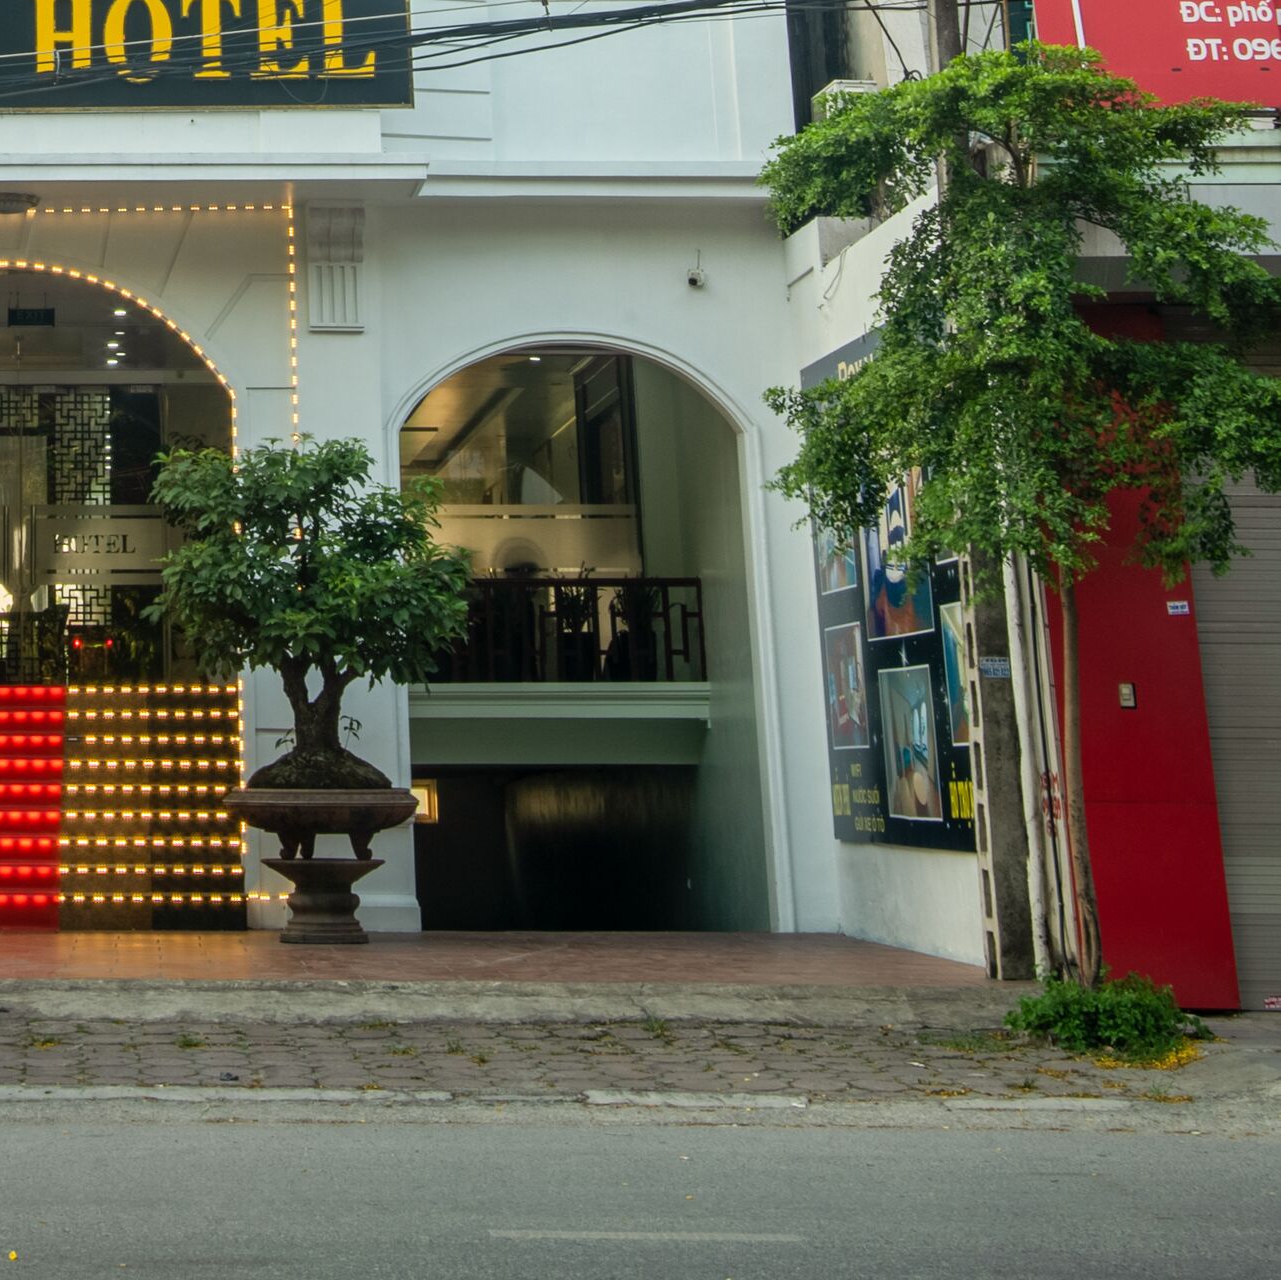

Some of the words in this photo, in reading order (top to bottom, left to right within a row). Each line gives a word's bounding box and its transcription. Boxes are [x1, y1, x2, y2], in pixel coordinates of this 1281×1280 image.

[1179, 0, 1223, 23] ĐC:
[1186, 38, 1229, 61] ĐT:
[53, 533, 136, 555] HOTEL
